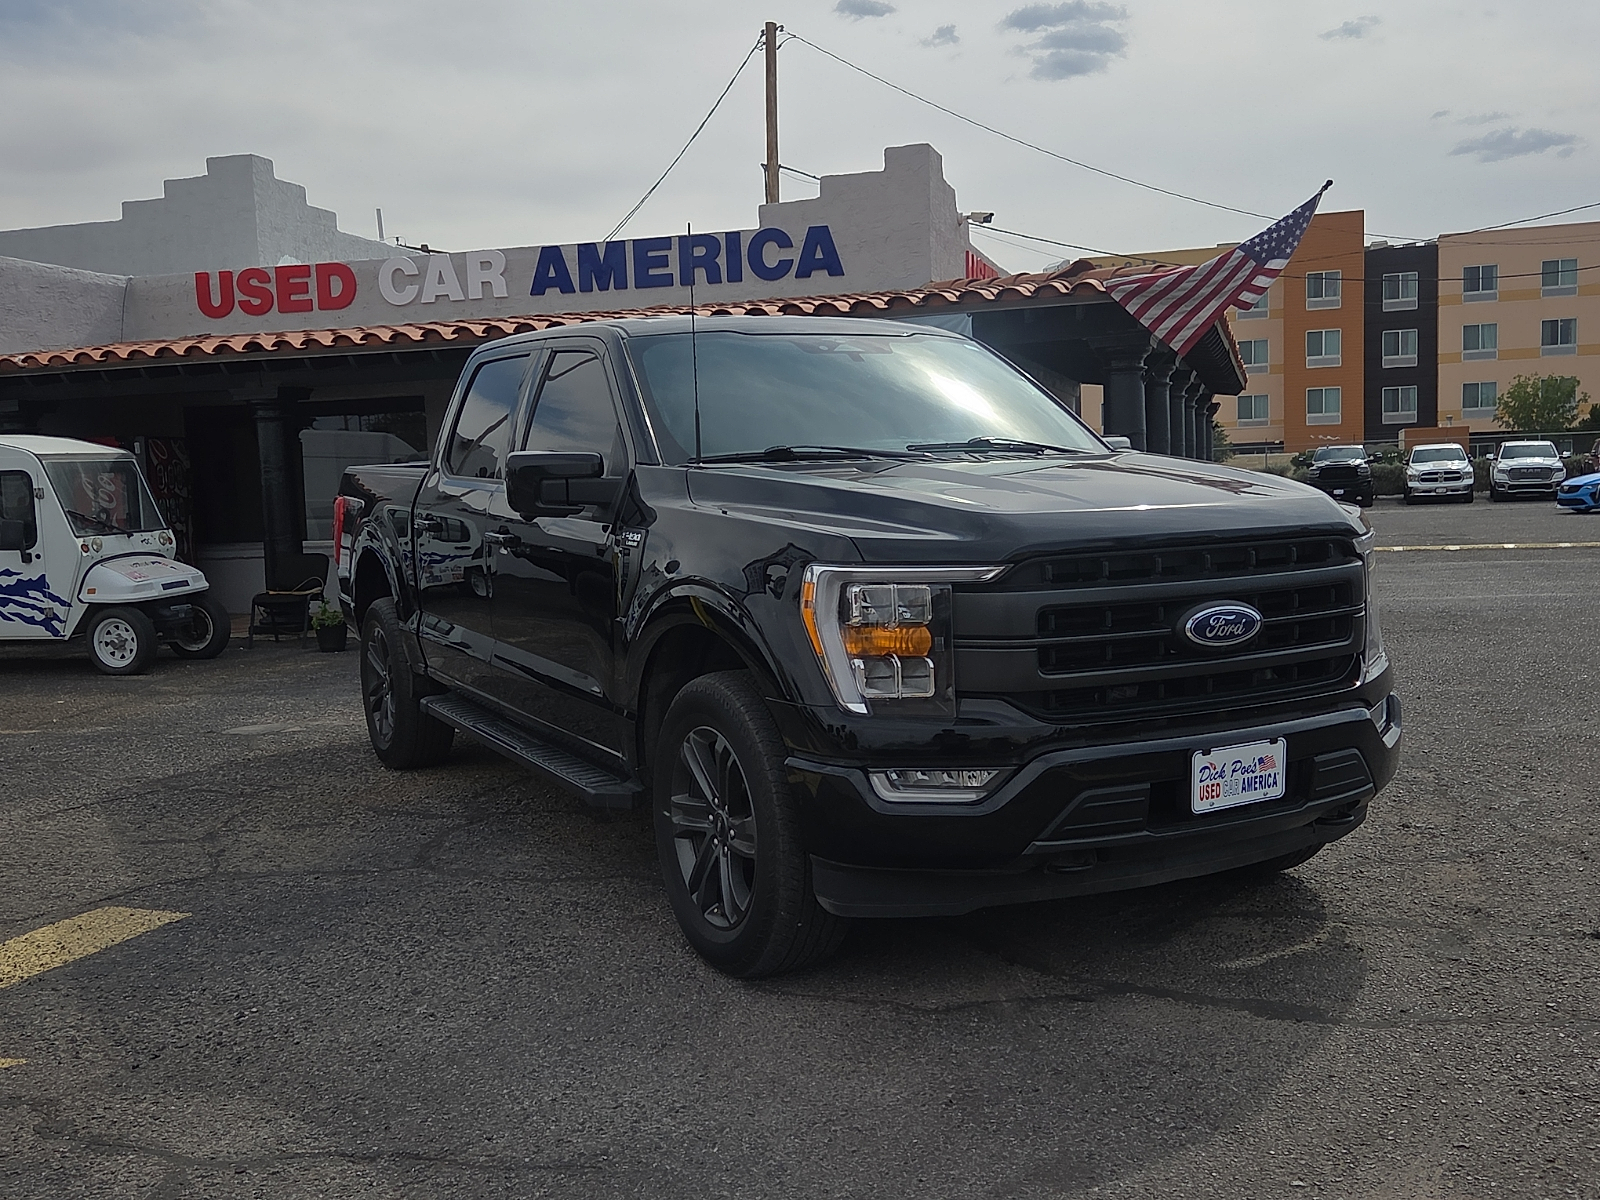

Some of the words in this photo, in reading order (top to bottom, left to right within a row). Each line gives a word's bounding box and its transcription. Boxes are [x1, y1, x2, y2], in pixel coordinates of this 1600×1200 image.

[195, 262, 357, 319] USED
[378, 250, 508, 306] CAR
[530, 225, 845, 296] AMERICA
[1206, 614, 1246, 638] Ford
[1199, 762, 1227, 783] Dick
[1230, 757, 1257, 779] Poe's
[1199, 783, 1221, 802] USED
[1223, 779, 1240, 798] CAR
[1241, 772, 1278, 794] AMERICA
